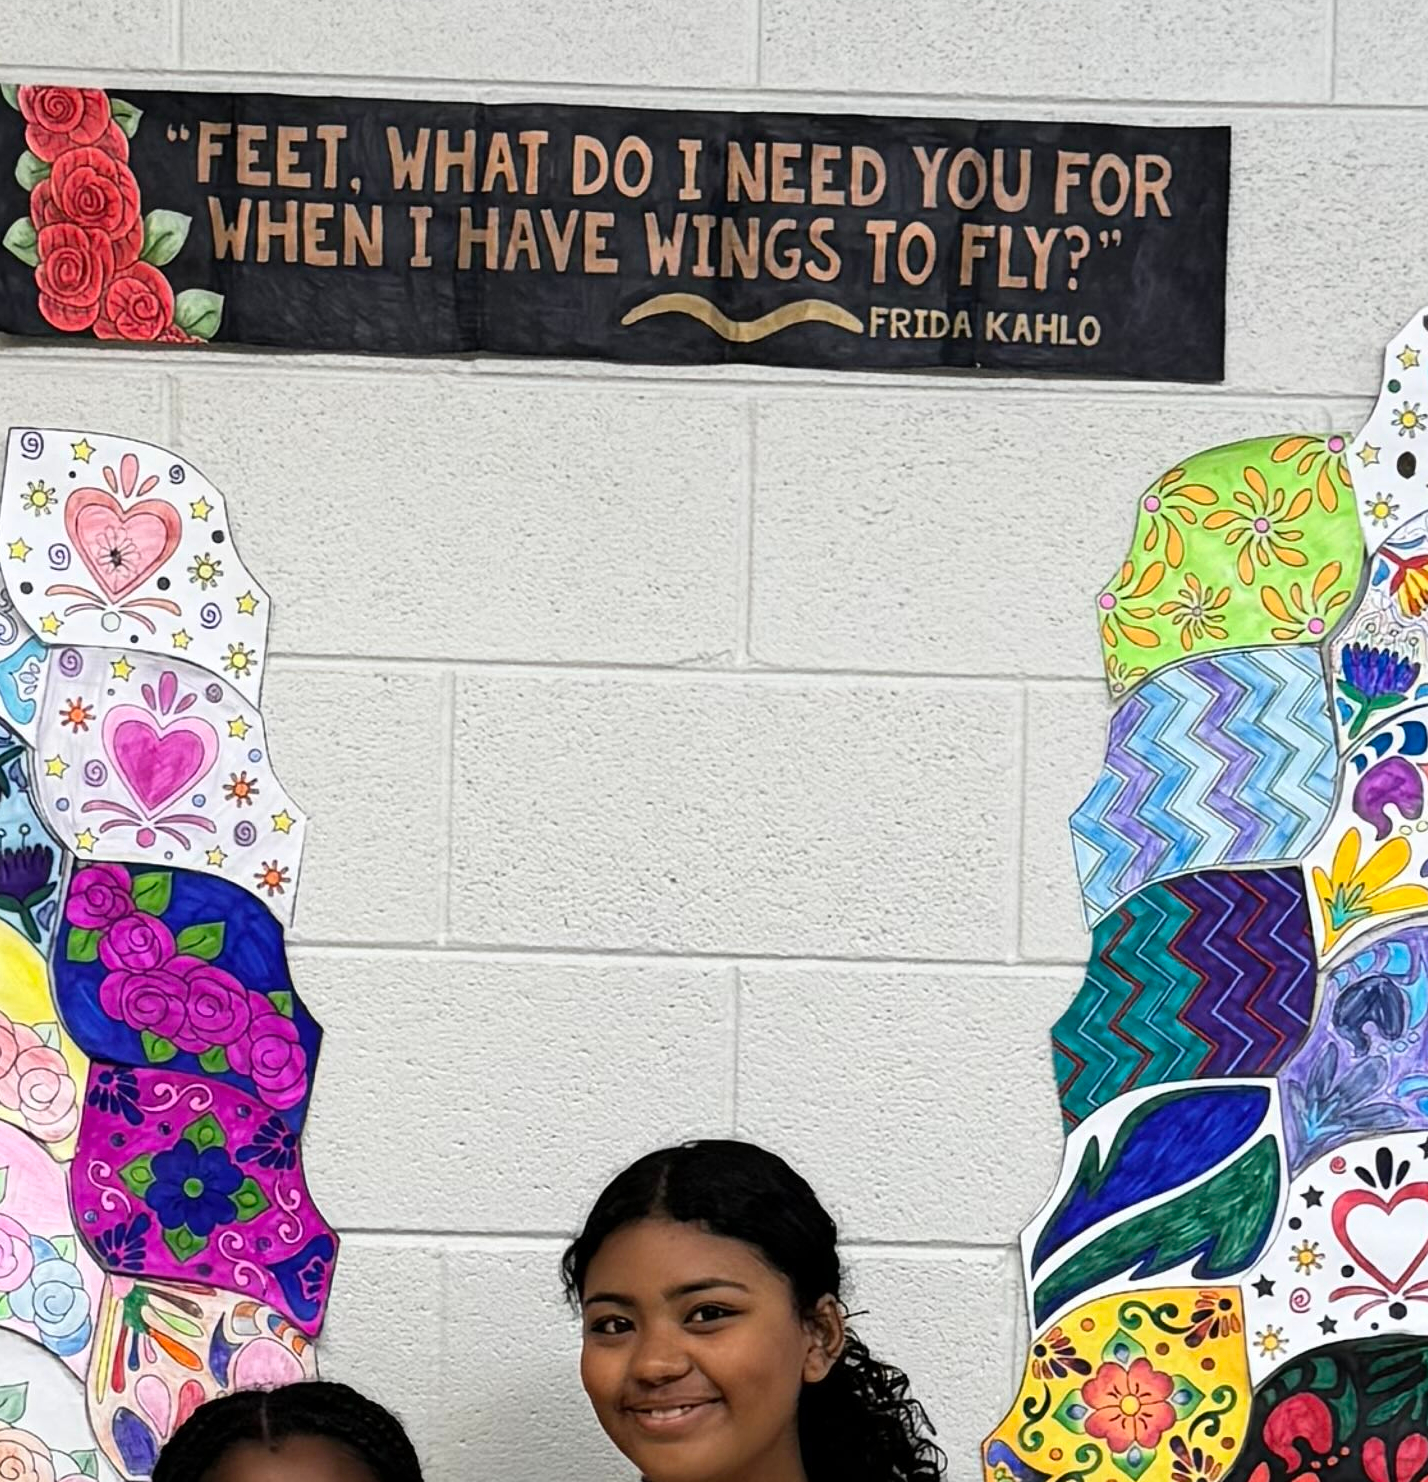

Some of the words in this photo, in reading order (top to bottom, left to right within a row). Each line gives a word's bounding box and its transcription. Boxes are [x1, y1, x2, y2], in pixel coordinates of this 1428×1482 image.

[386, 126, 549, 195] WHAT
[572, 134, 653, 198] DO
[677, 138, 703, 201] I
[727, 141, 887, 207] NEED
[912, 146, 1032, 213] YOU
[1054, 150, 1172, 218] FOR
[208, 197, 384, 267] WHEN
[410, 206, 433, 268] I
[457, 207, 619, 274] HAVE
[644, 212, 842, 282] WINGS
[866, 219, 936, 286] TO
[869, 306, 973, 339] FRIDA
[985, 311, 1101, 347] KAHLO
